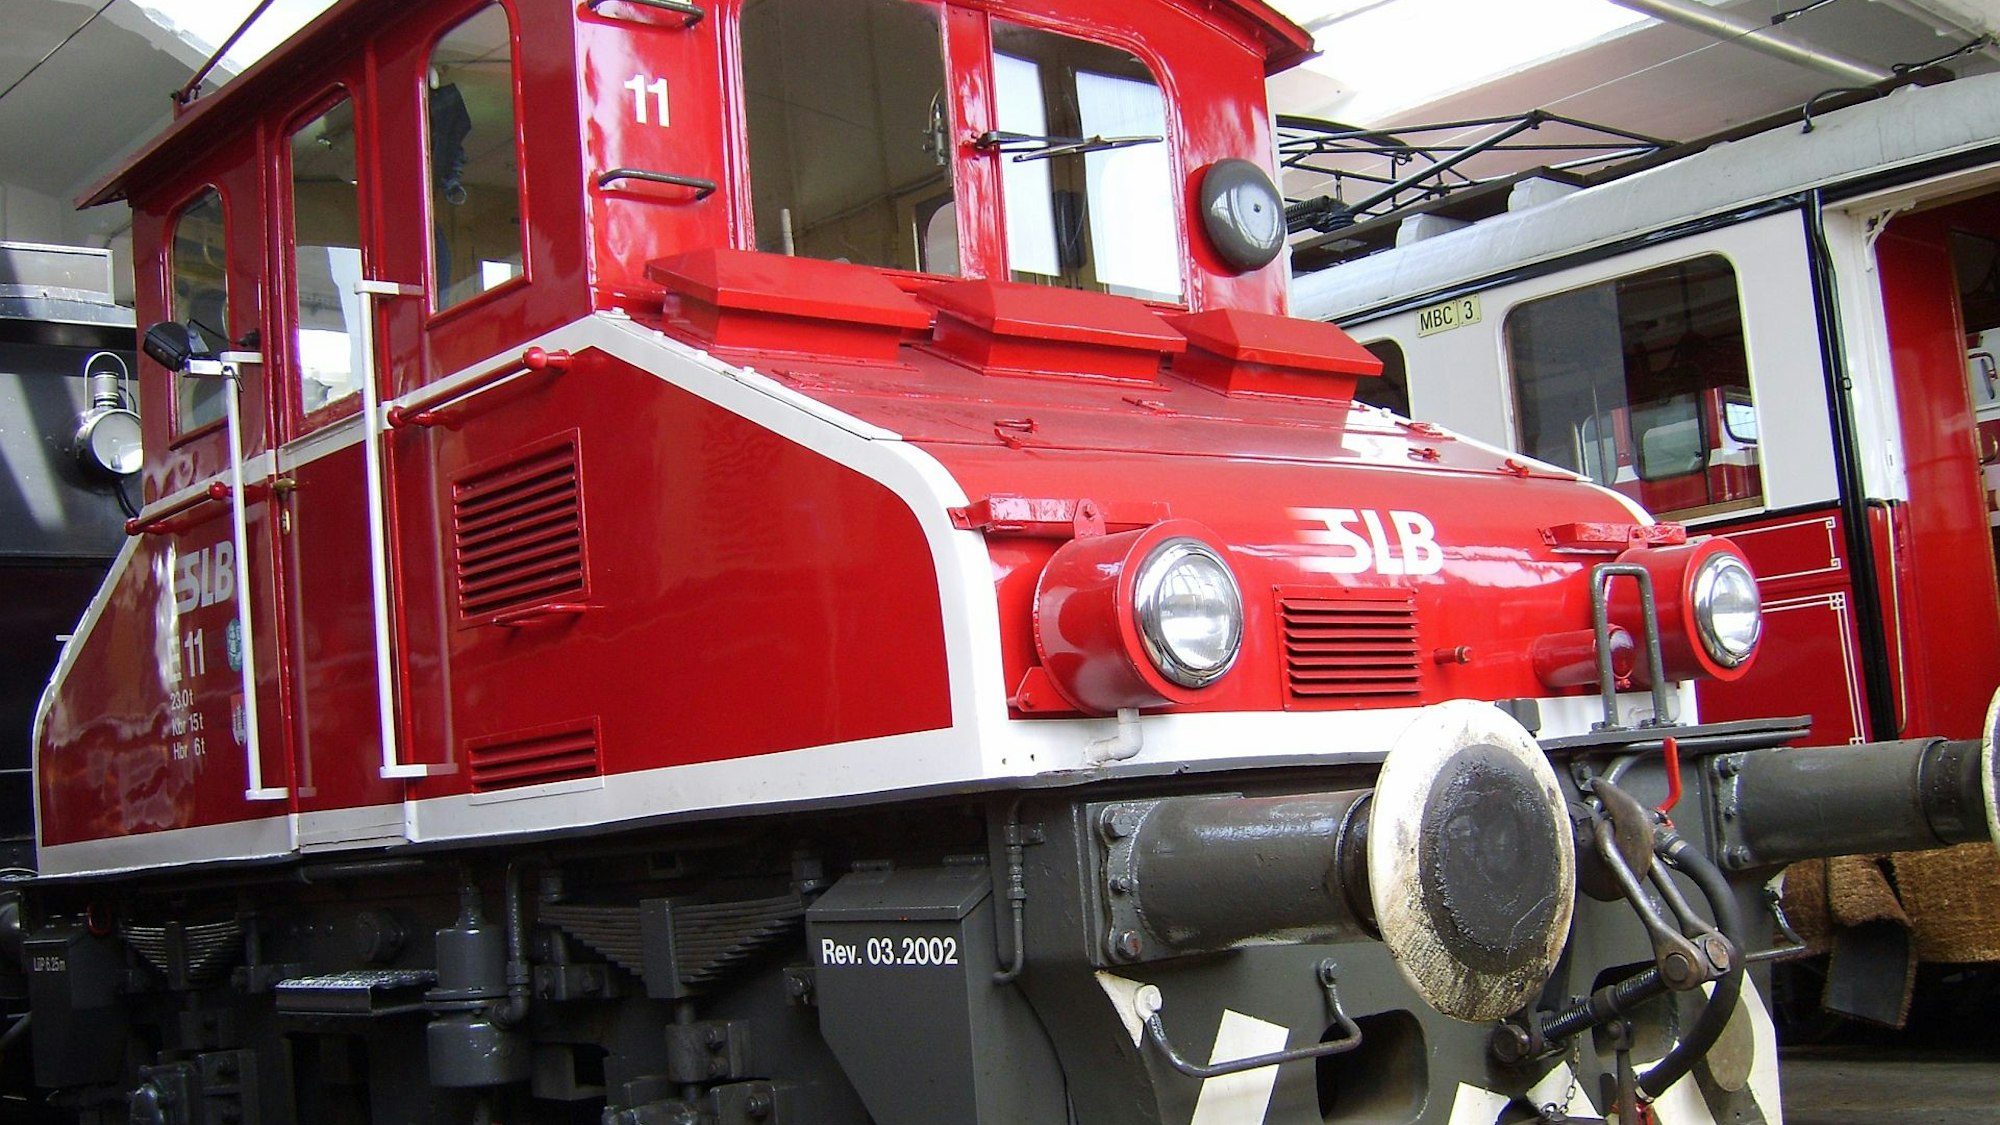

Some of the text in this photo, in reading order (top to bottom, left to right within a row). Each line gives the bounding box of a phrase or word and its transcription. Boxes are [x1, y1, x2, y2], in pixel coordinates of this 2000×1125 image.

[623, 74, 671, 129] 11
[1419, 300, 1474, 331] MBC 3
[1284, 506, 1444, 575] SLB
[174, 540, 235, 616] SLB
[184, 628, 205, 678] 11
[173, 741, 189, 760] Hbr
[821, 937, 959, 965] Rev. 03.2002
